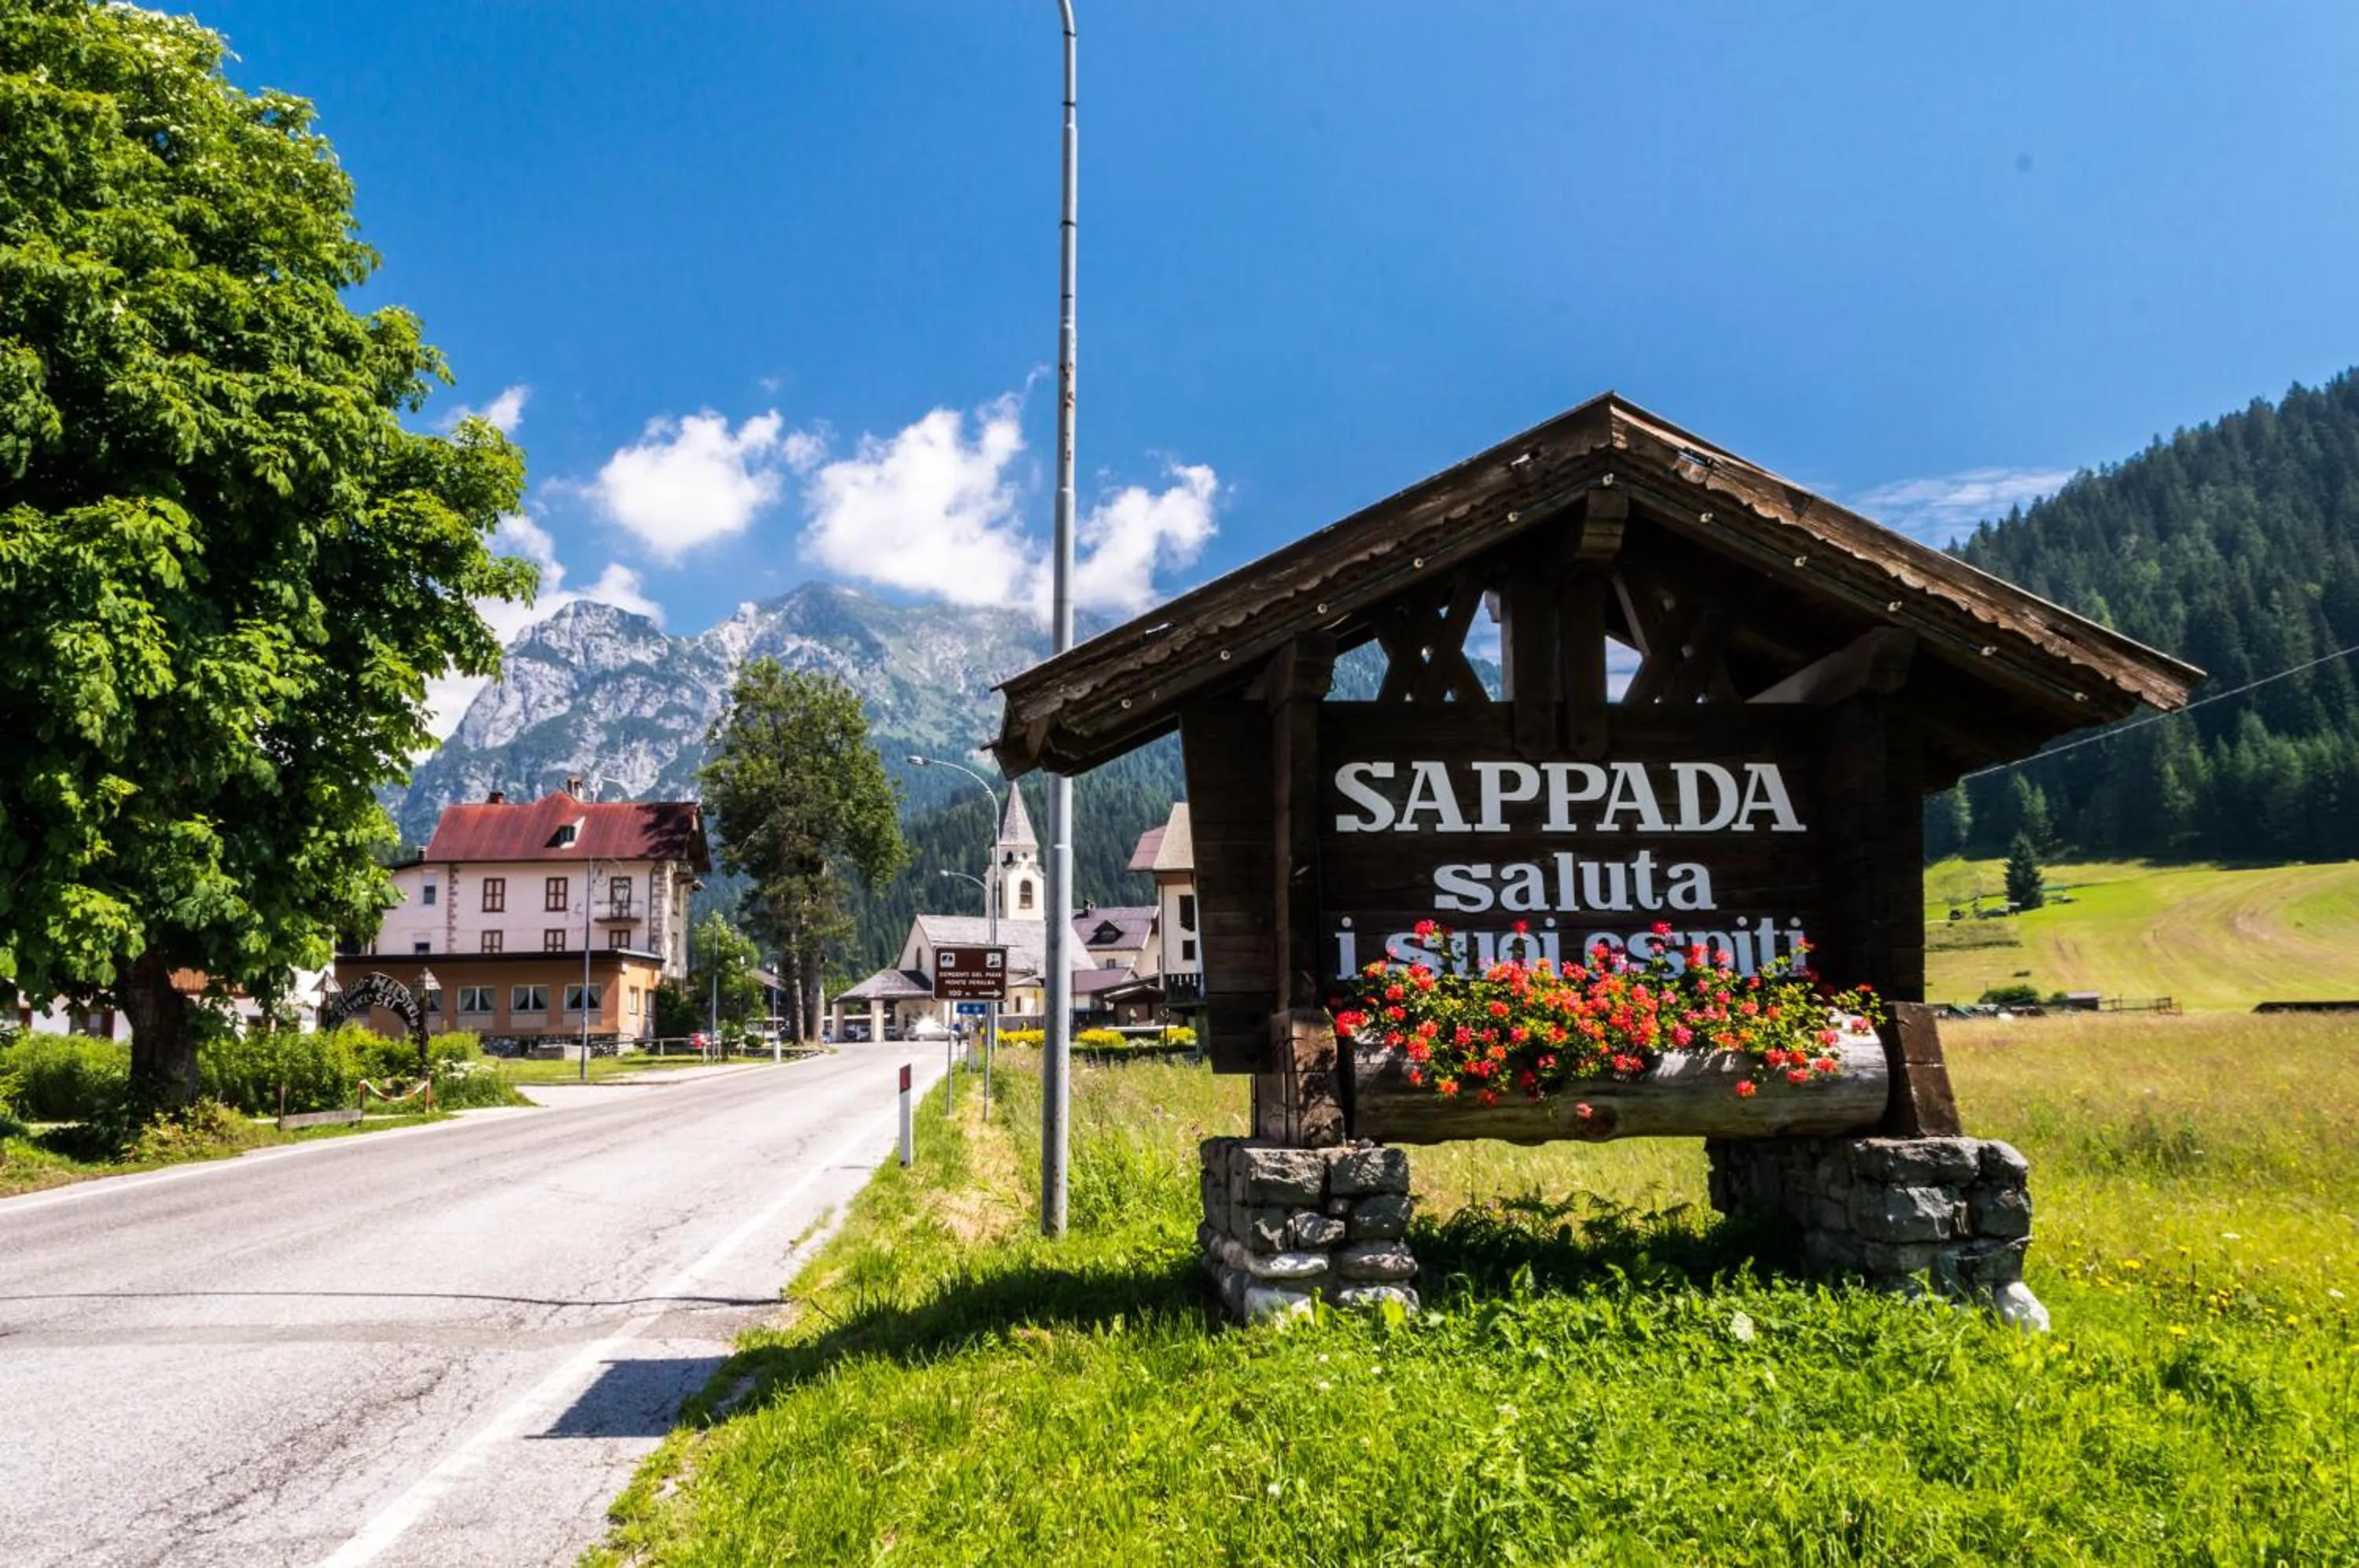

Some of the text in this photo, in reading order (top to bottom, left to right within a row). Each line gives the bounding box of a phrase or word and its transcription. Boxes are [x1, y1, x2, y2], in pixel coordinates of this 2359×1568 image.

[1335, 760, 1807, 833] SAPPADA
[1433, 849, 1717, 913] saluta
[1334, 915, 1359, 981] i
